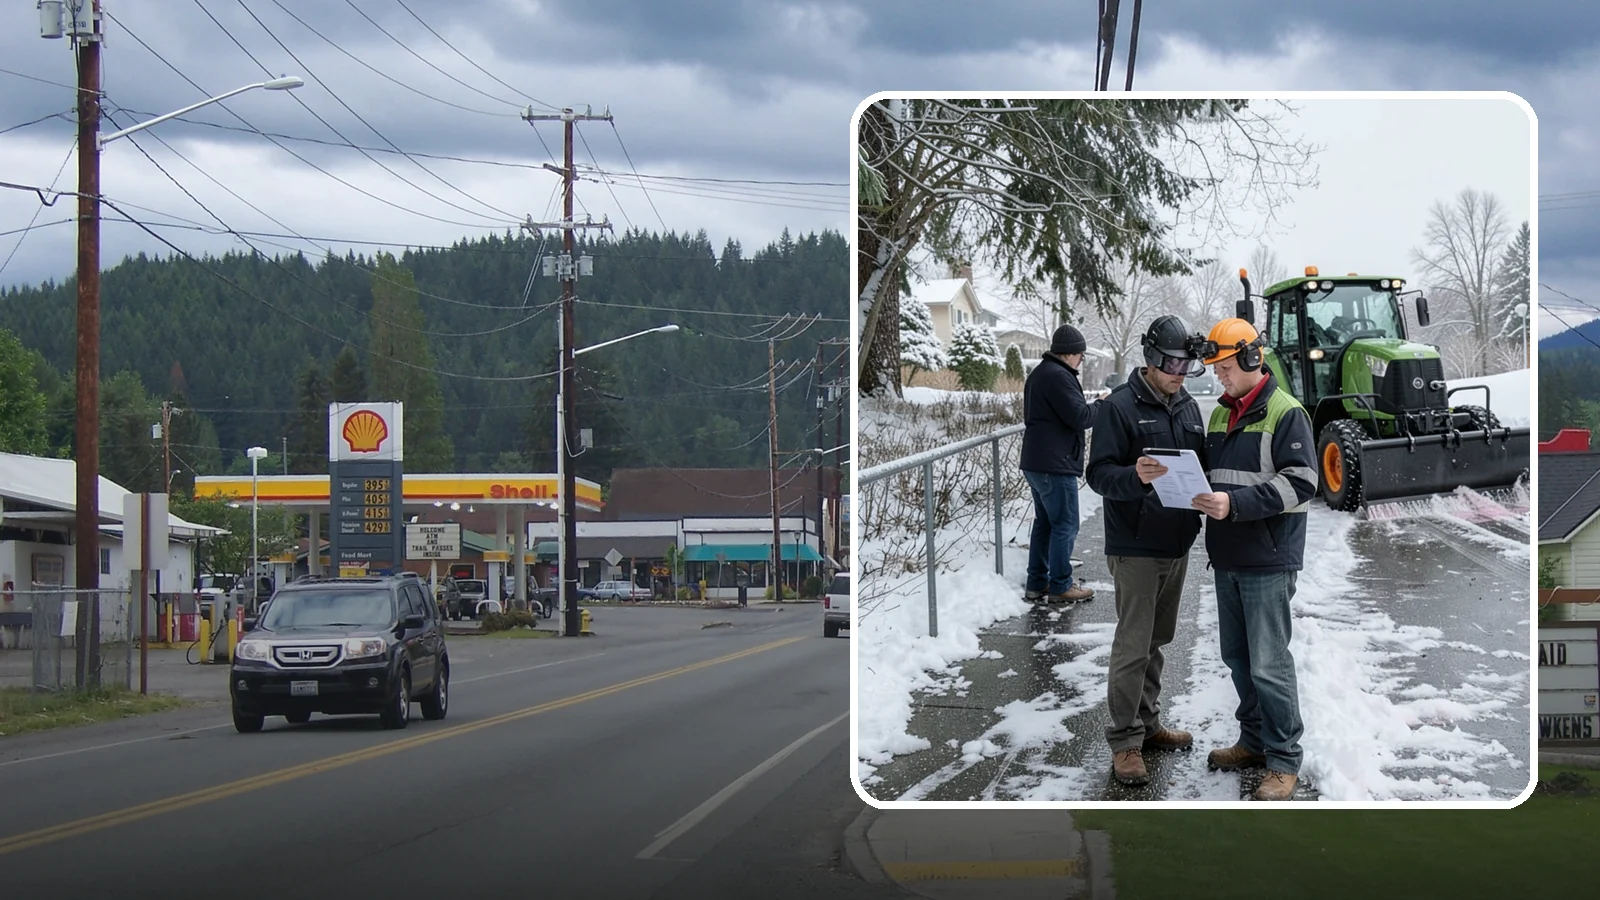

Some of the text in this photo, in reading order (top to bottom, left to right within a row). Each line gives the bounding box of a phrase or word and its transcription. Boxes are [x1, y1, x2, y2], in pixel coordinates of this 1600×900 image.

[366, 480, 383, 490] 395
[490, 484, 547, 499] Shell
[366, 494, 383, 504] 405
[366, 508, 383, 518] 415
[366, 522, 383, 532] 429
